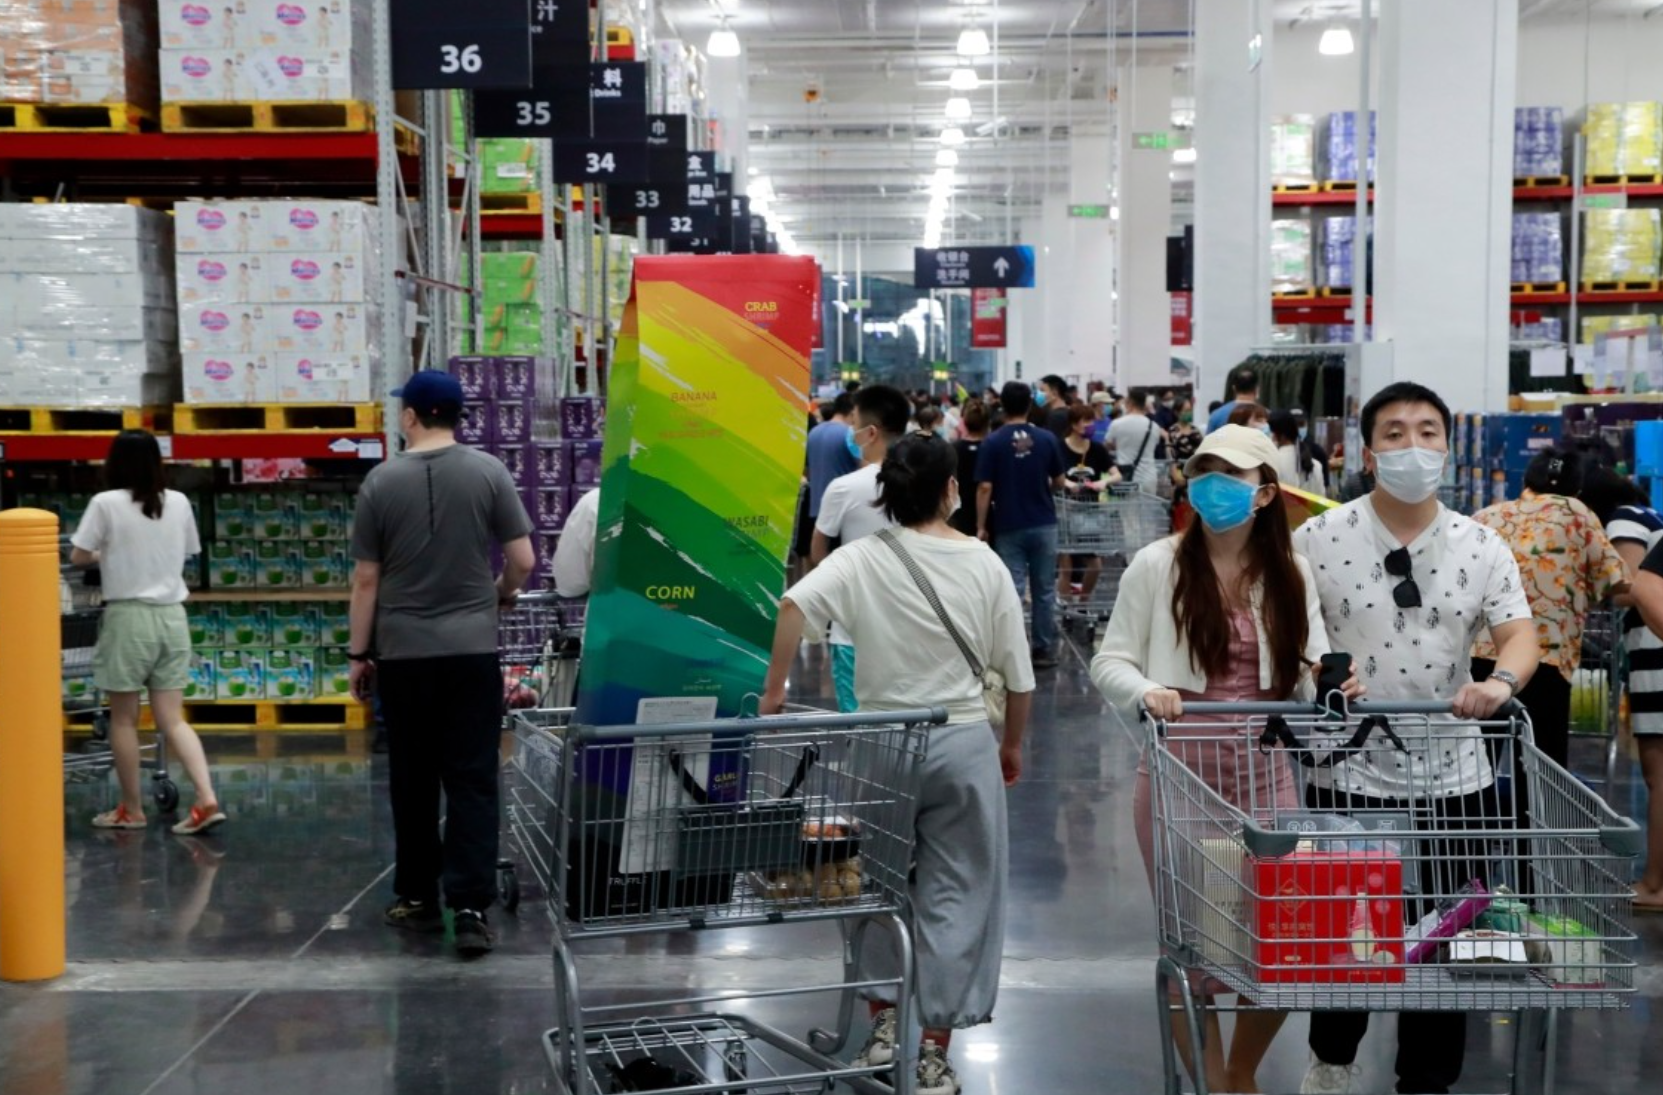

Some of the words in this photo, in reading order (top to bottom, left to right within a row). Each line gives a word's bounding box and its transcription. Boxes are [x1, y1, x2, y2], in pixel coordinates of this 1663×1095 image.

[440, 44, 482, 73] 36
[603, 68, 622, 87] 料
[594, 88, 622, 97] Drinks
[516, 101, 551, 125] 35
[651, 120, 666, 136] 巾
[586, 152, 616, 173] 34
[635, 190, 660, 208] 33
[670, 216, 693, 232] 32
[744, 301, 777, 312] CRAB
[671, 391, 718, 403] BANANA
[645, 586, 696, 600] CORN
